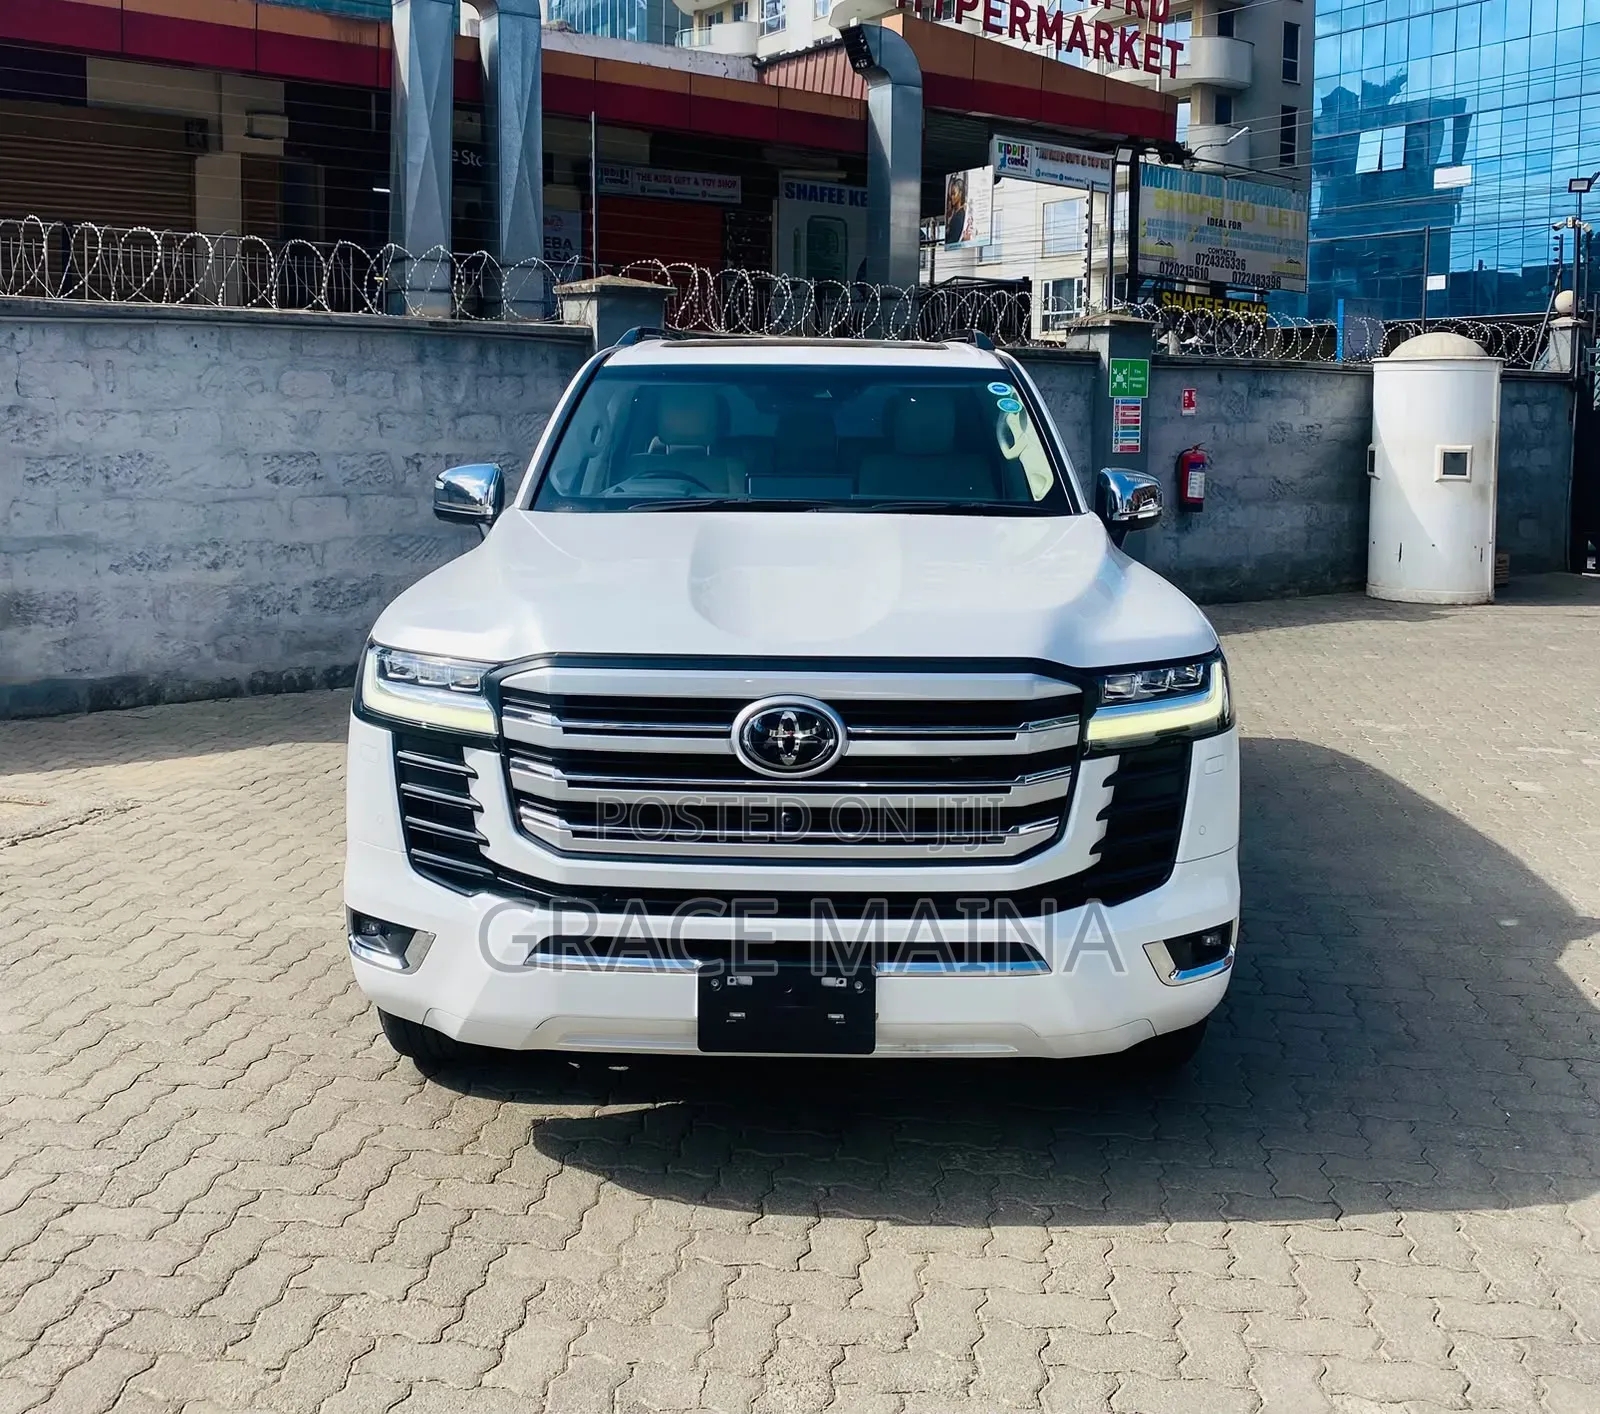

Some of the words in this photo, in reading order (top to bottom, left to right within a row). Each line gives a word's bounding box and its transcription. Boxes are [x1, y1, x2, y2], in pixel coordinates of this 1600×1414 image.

[896, 0, 1184, 79] PERMARKET
[636, 172, 652, 182] THE
[653, 174, 672, 184] KIDS
[701, 178, 715, 187] TOY
[717, 179, 737, 189] SHOP
[784, 181, 845, 206] SHAFEE
[1206, 216, 1227, 229] IDEAL
[1228, 219, 1242, 231] FOR
[1195, 252, 1246, 271] 0724325336
[1208, 247, 1237, 257] CONTACTS
[1159, 261, 1209, 280] 0720215610
[1232, 271, 1282, 289] 0722483396
[1161, 291, 1224, 319] SHAFEE
[1228, 299, 1268, 323] KEYS
